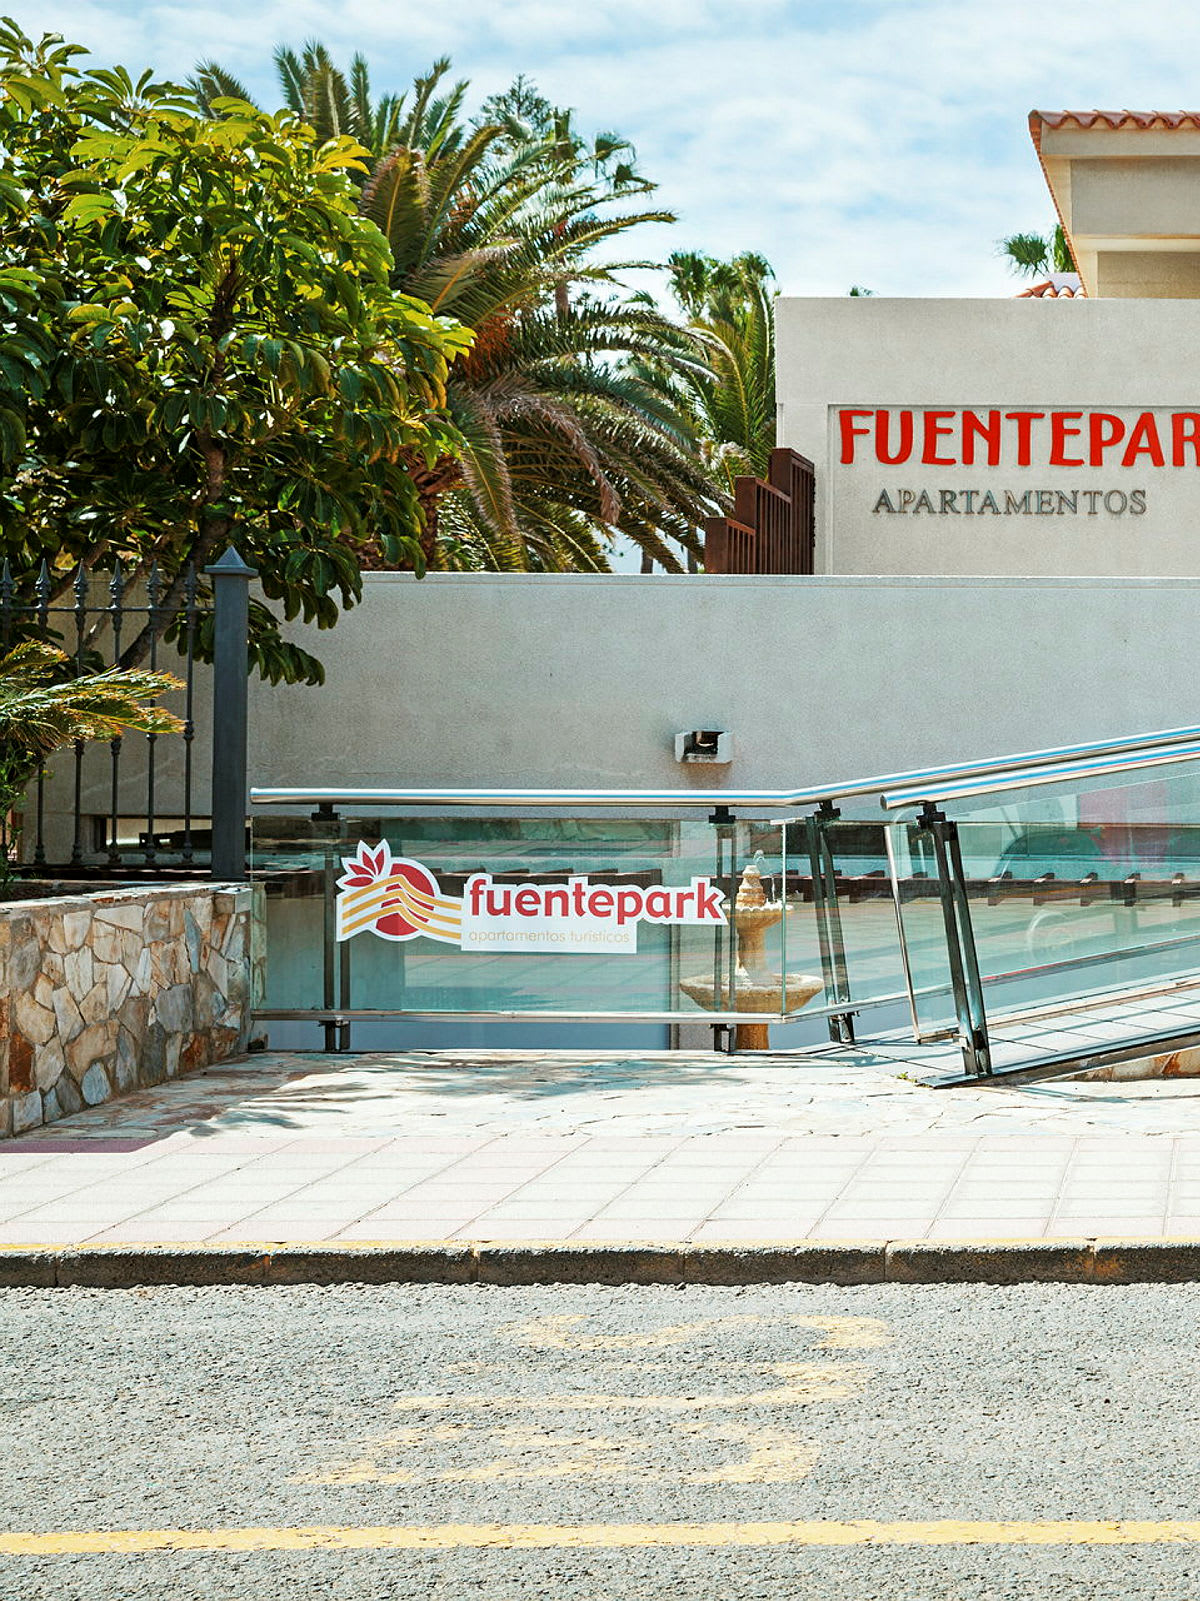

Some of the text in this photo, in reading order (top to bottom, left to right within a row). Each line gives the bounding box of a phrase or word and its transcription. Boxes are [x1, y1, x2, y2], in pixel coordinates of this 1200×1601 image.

[871, 489, 1147, 515] APARTAMENTOS
[469, 879, 722, 925] fuentepark
[468, 930, 566, 944] apartamentos
